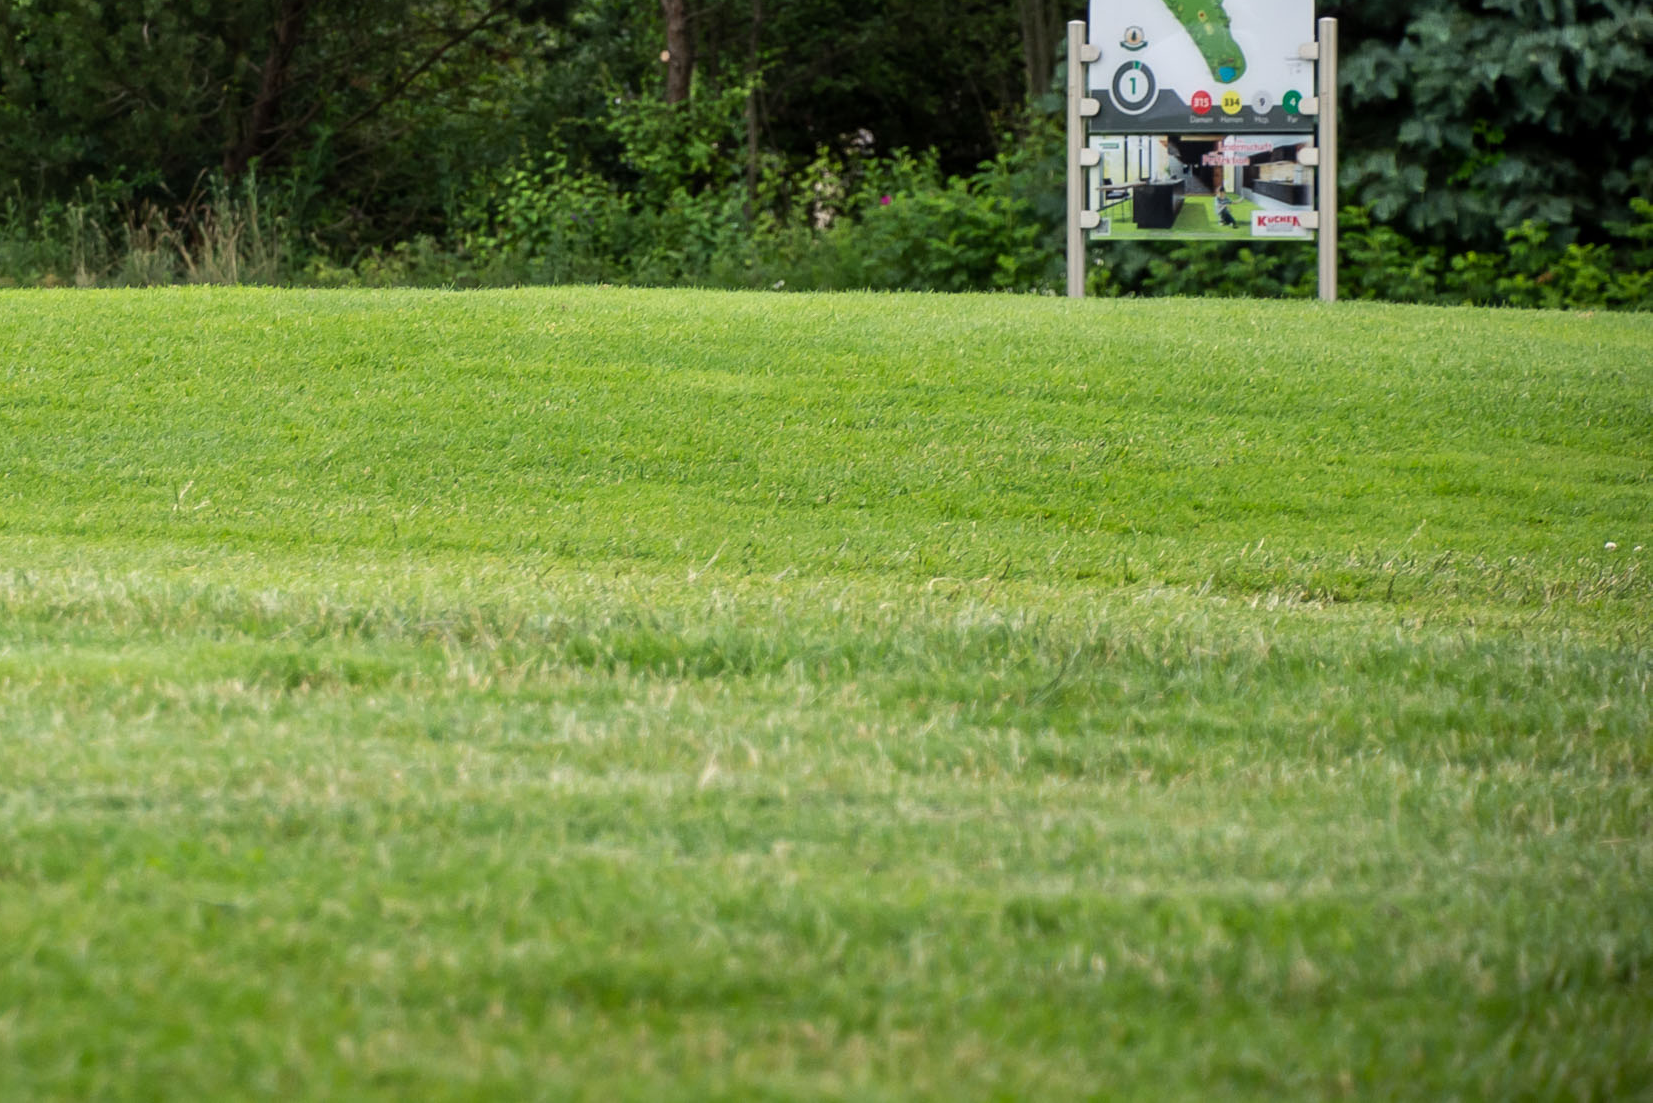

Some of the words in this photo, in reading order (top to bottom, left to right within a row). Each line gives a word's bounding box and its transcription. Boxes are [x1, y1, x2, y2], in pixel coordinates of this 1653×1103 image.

[1129, 77, 1136, 95] 1
[1224, 97, 1241, 107] 334
[1259, 97, 1266, 107] 9
[1289, 97, 1296, 107] 4
[1190, 115, 1214, 124] Damen
